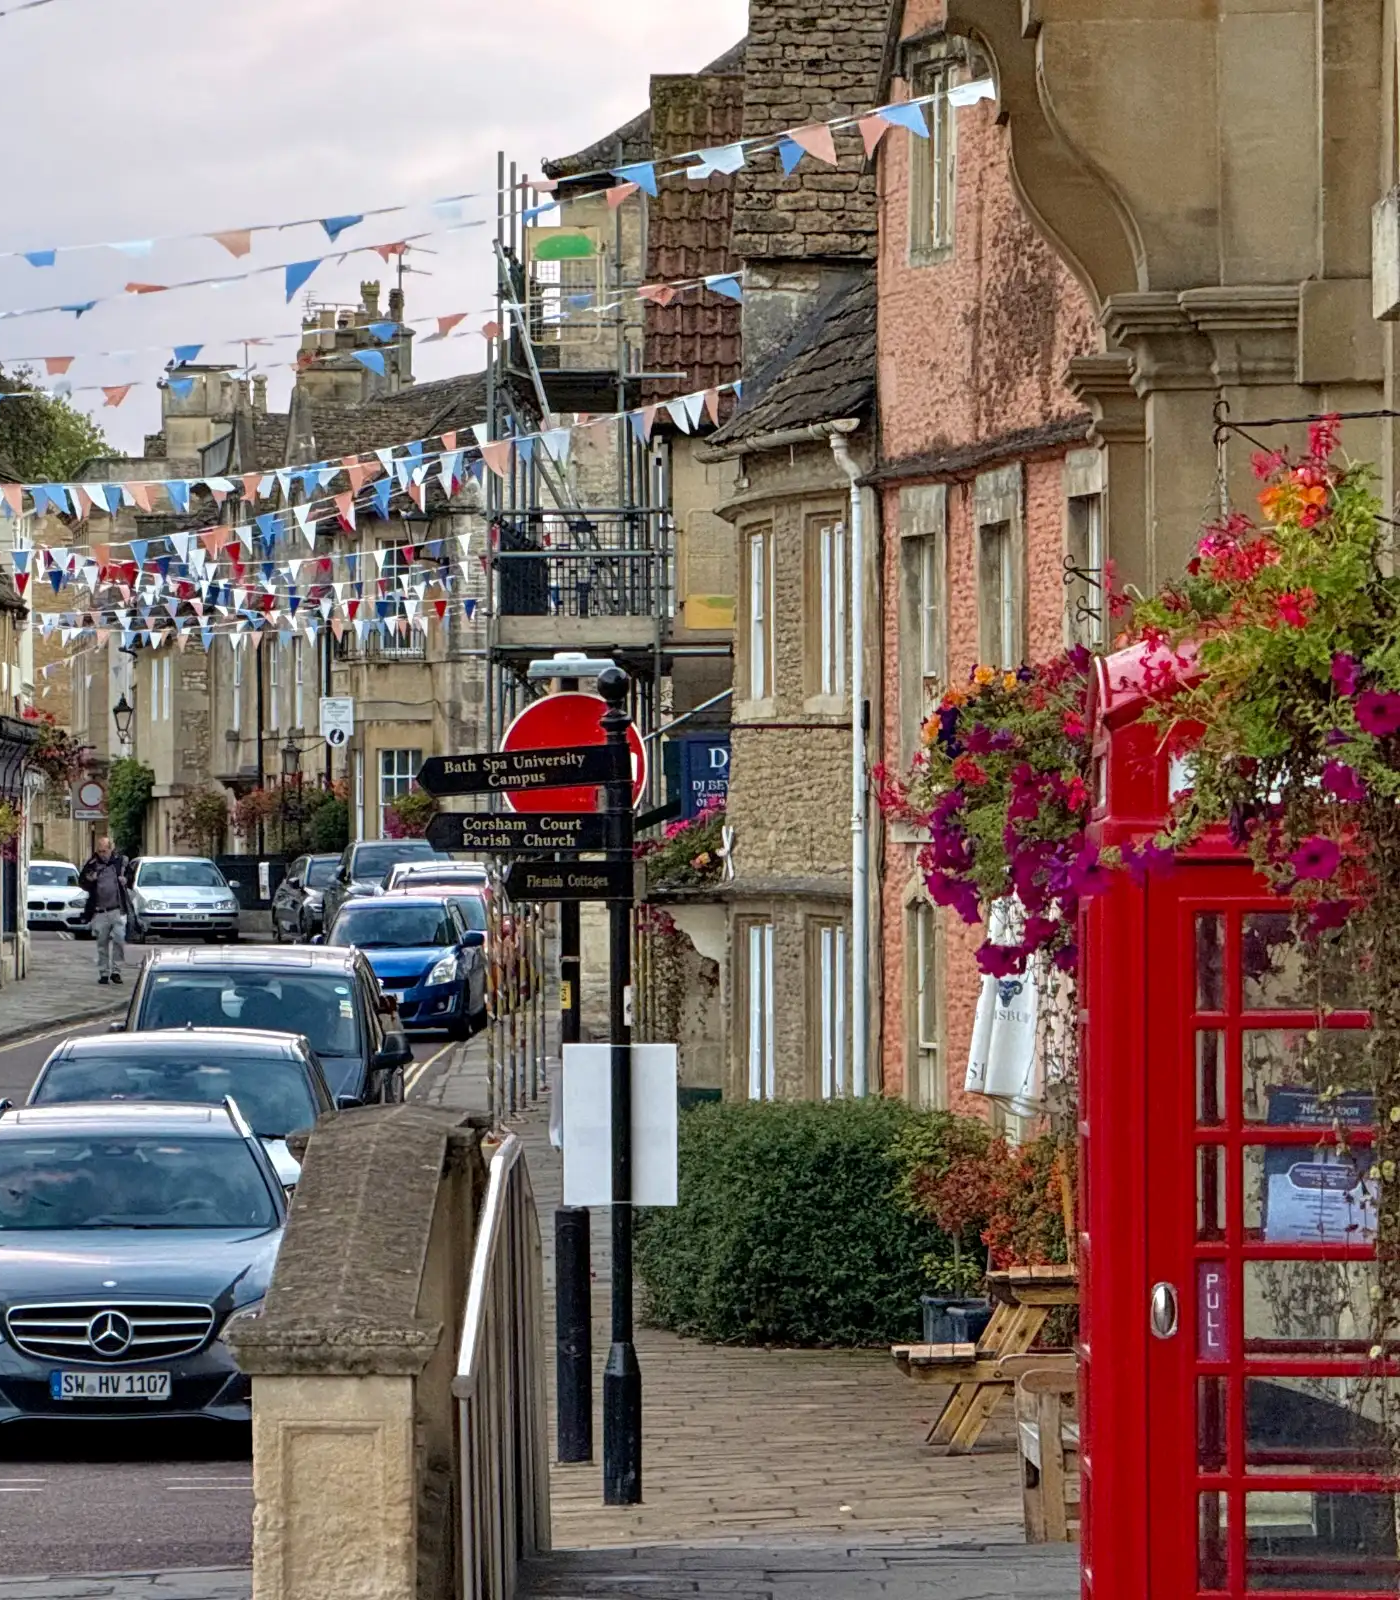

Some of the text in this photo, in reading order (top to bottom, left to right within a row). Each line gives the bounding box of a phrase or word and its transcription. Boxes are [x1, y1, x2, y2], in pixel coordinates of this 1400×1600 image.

[444, 752, 586, 775] Bath Spa University
[488, 772, 546, 787] Campus
[462, 817, 583, 831] Corsham Court
[462, 833, 576, 848] Parish Church
[526, 874, 609, 888] Flemish Cottages
[1206, 1273, 1220, 1347] PULL
[63, 1374, 168, 1394] SW HV 1107
